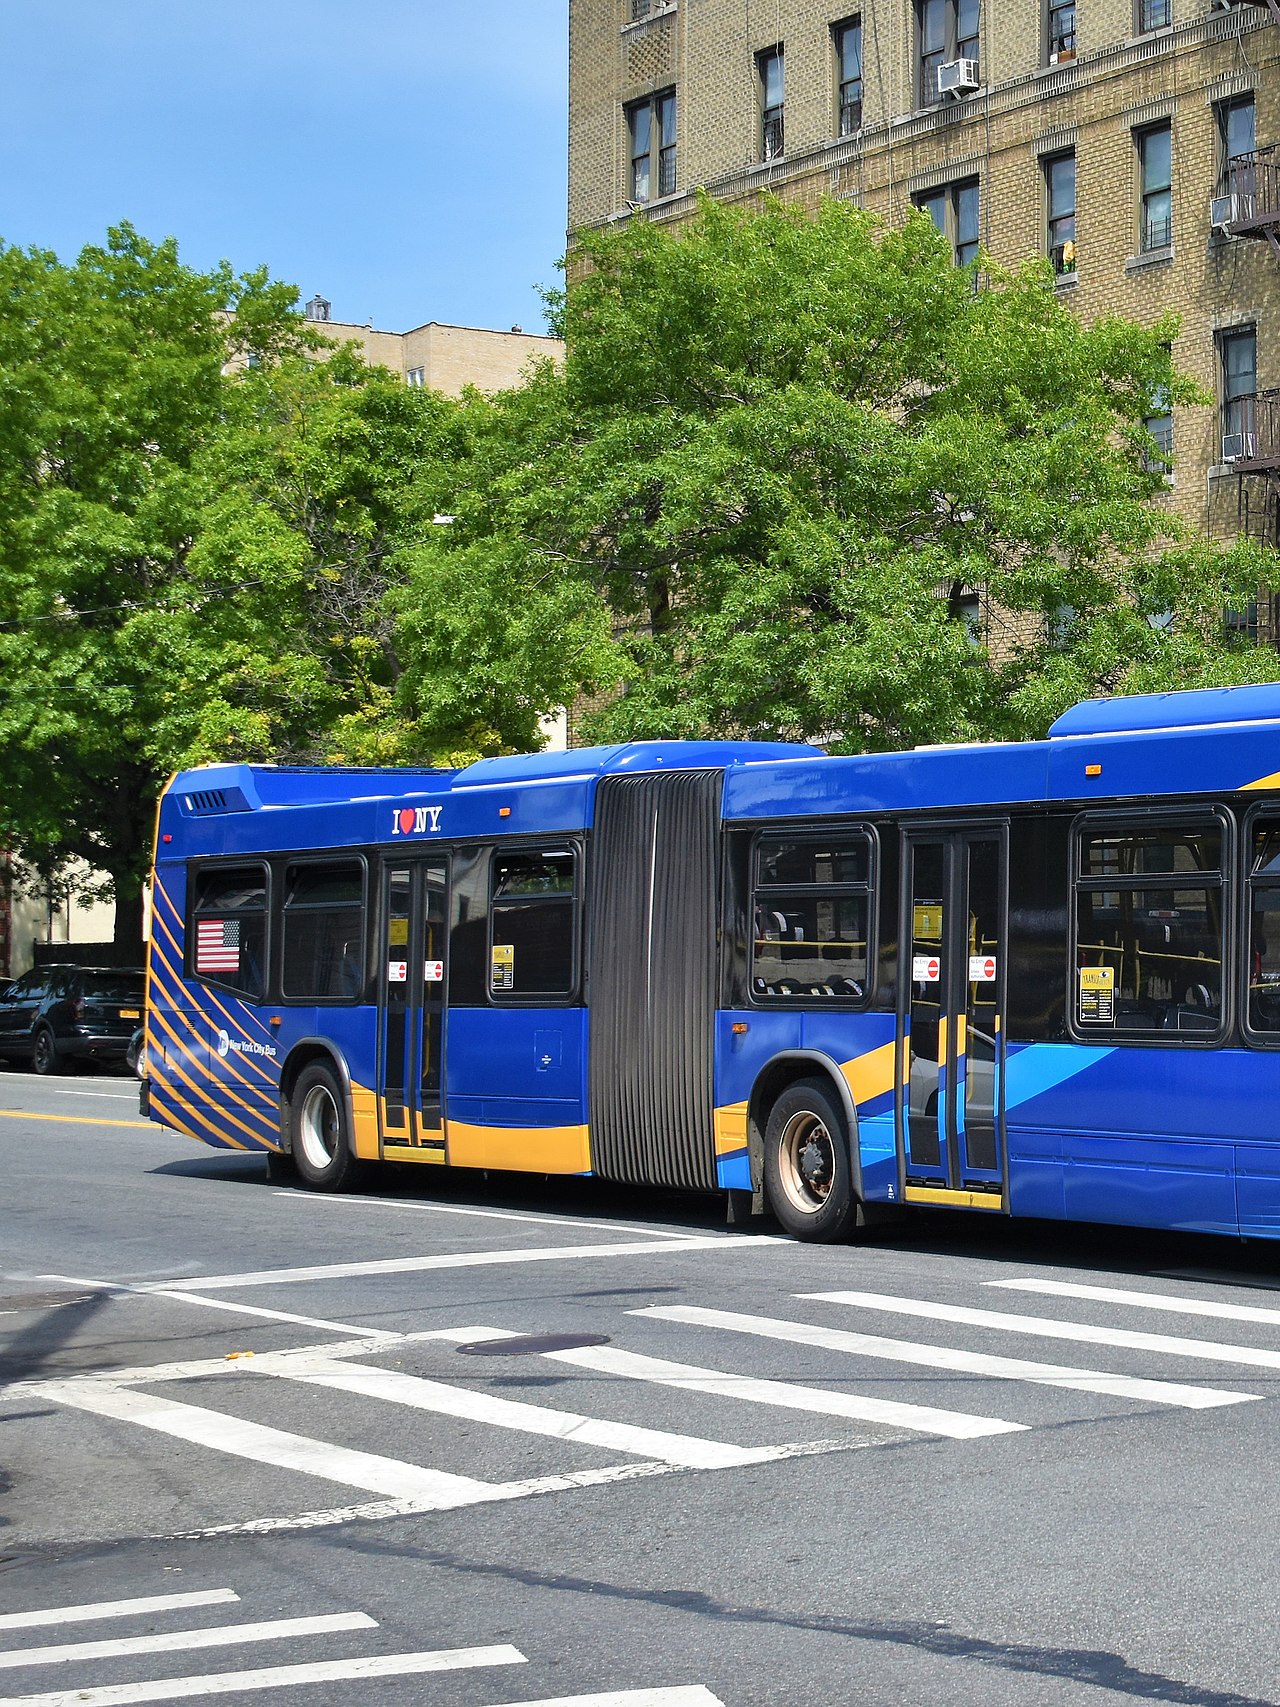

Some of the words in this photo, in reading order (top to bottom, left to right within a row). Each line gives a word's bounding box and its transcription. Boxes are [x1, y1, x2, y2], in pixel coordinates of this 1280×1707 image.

[391, 809, 401, 835] I
[241, 1041, 253, 1053] York
[253, 1043, 265, 1056] City
[265, 1044, 277, 1056] Bus
